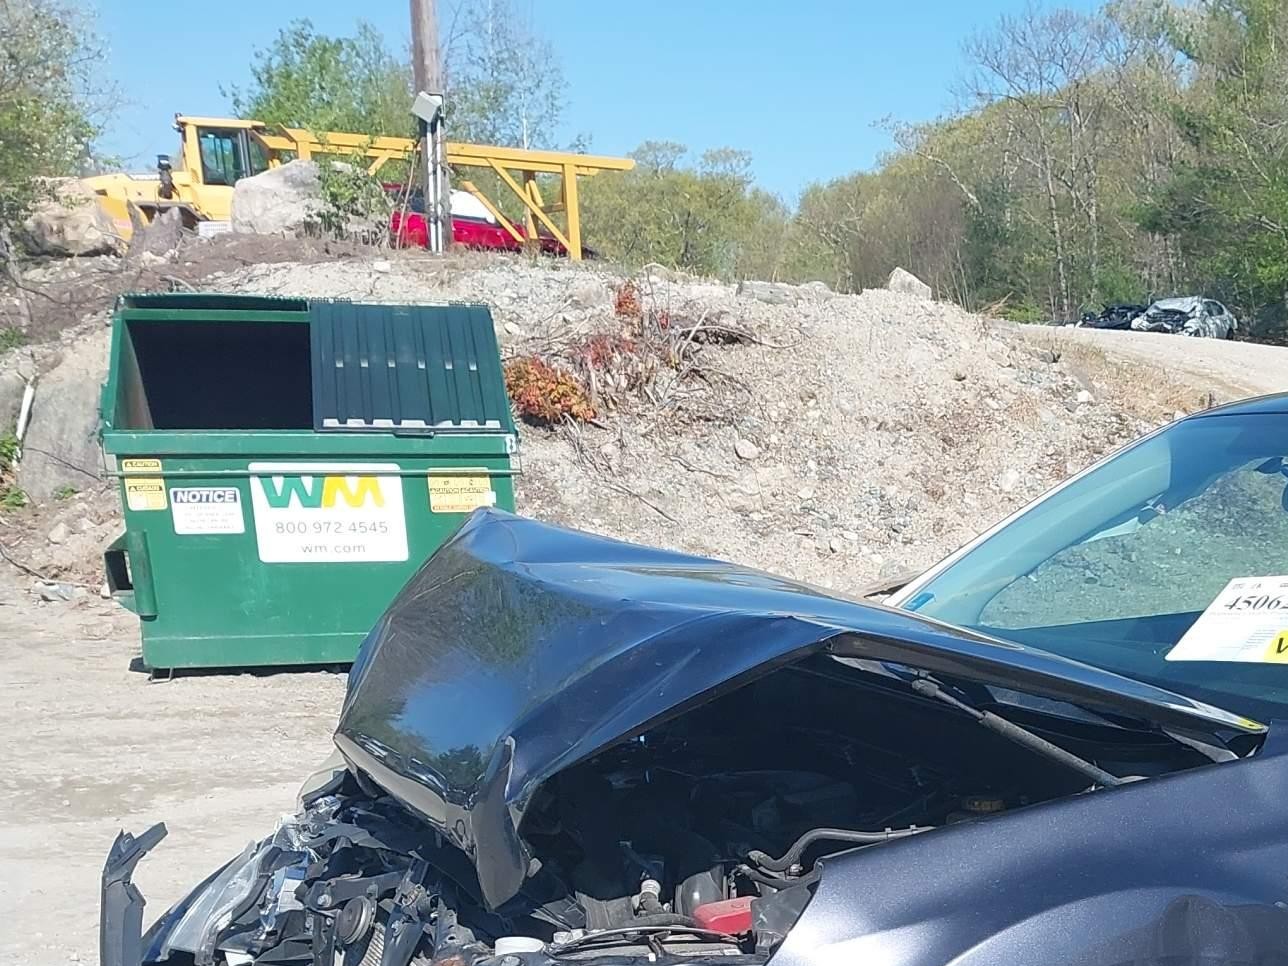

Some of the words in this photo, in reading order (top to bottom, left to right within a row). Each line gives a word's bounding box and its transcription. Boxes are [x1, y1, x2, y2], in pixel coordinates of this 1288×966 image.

[176, 490, 236, 503] NOTICE
[259, 474, 385, 509] WM
[275, 521, 307, 534] 800
[312, 521, 344, 534] 972
[348, 521, 388, 534] 4545
